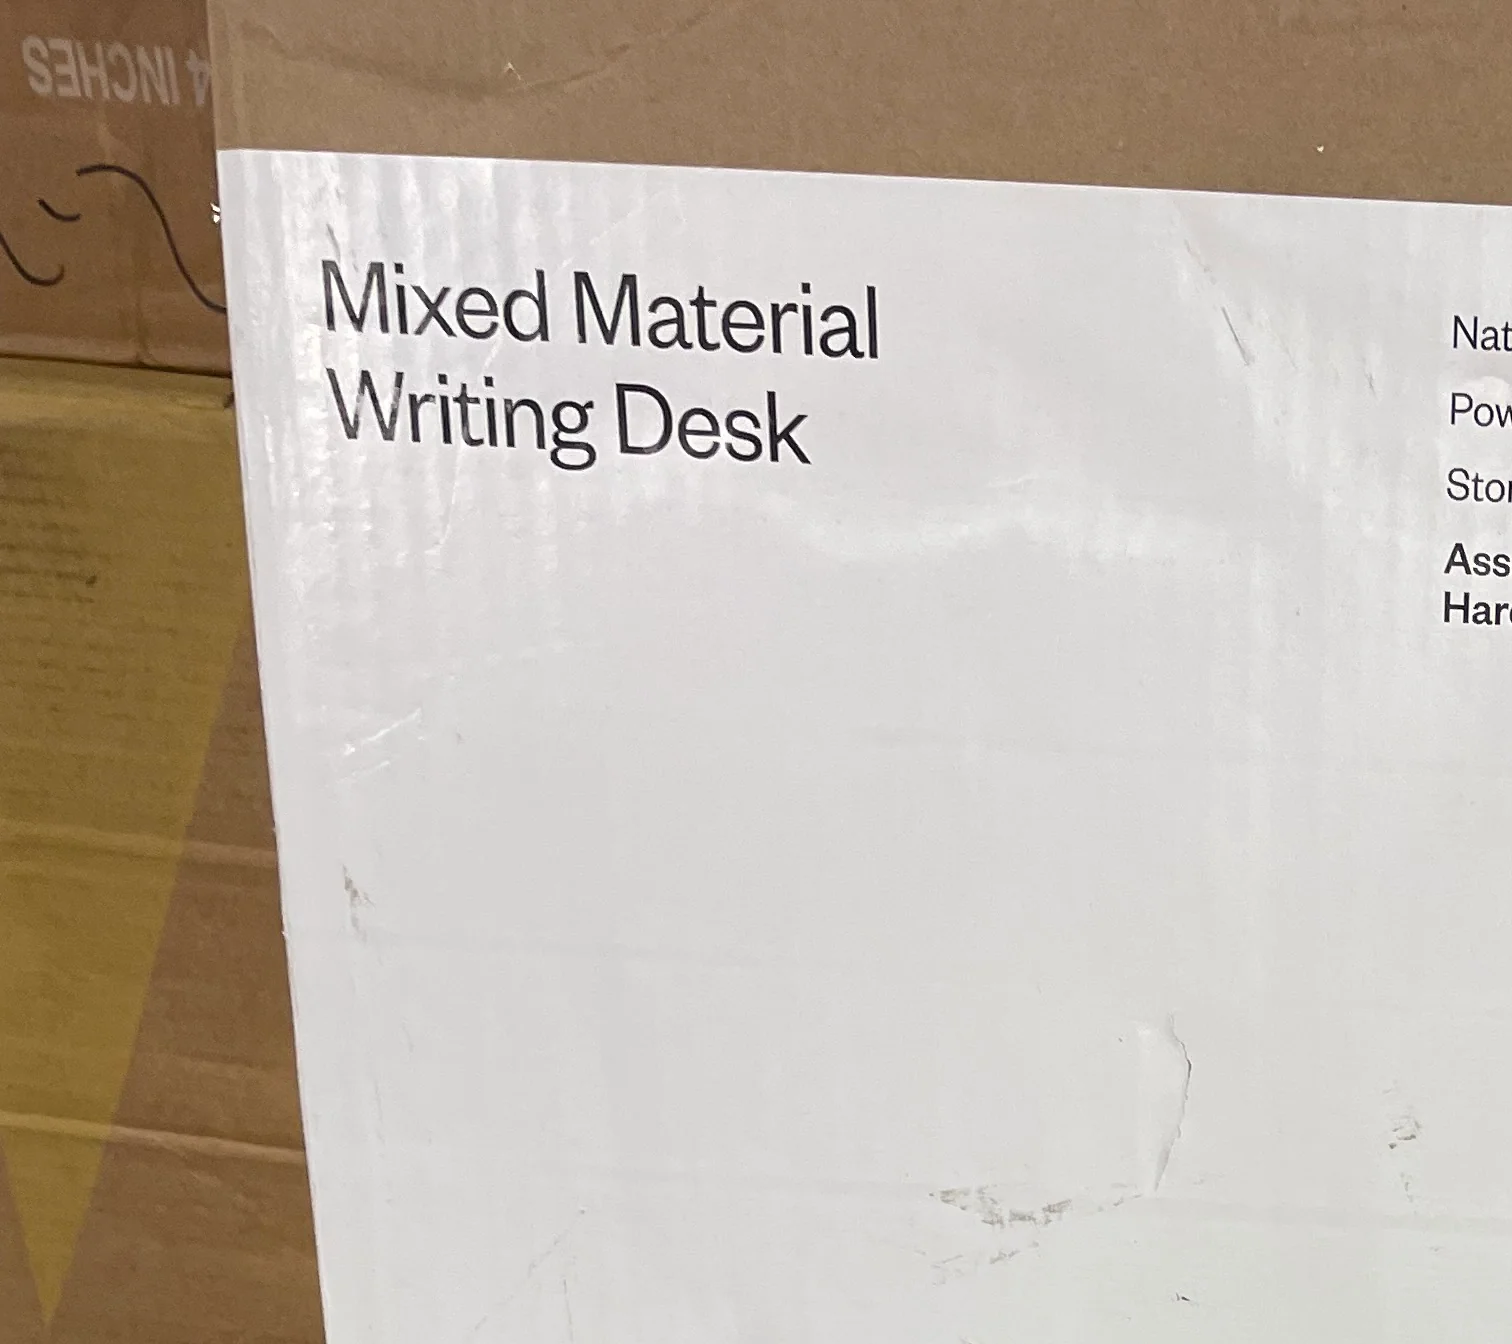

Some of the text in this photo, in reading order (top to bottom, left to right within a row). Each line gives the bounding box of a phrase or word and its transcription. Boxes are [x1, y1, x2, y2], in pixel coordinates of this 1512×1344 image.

[21, 35, 181, 105] INCHES
[321, 258, 878, 359] Mixed Material
[326, 367, 811, 471] Writing Desk
